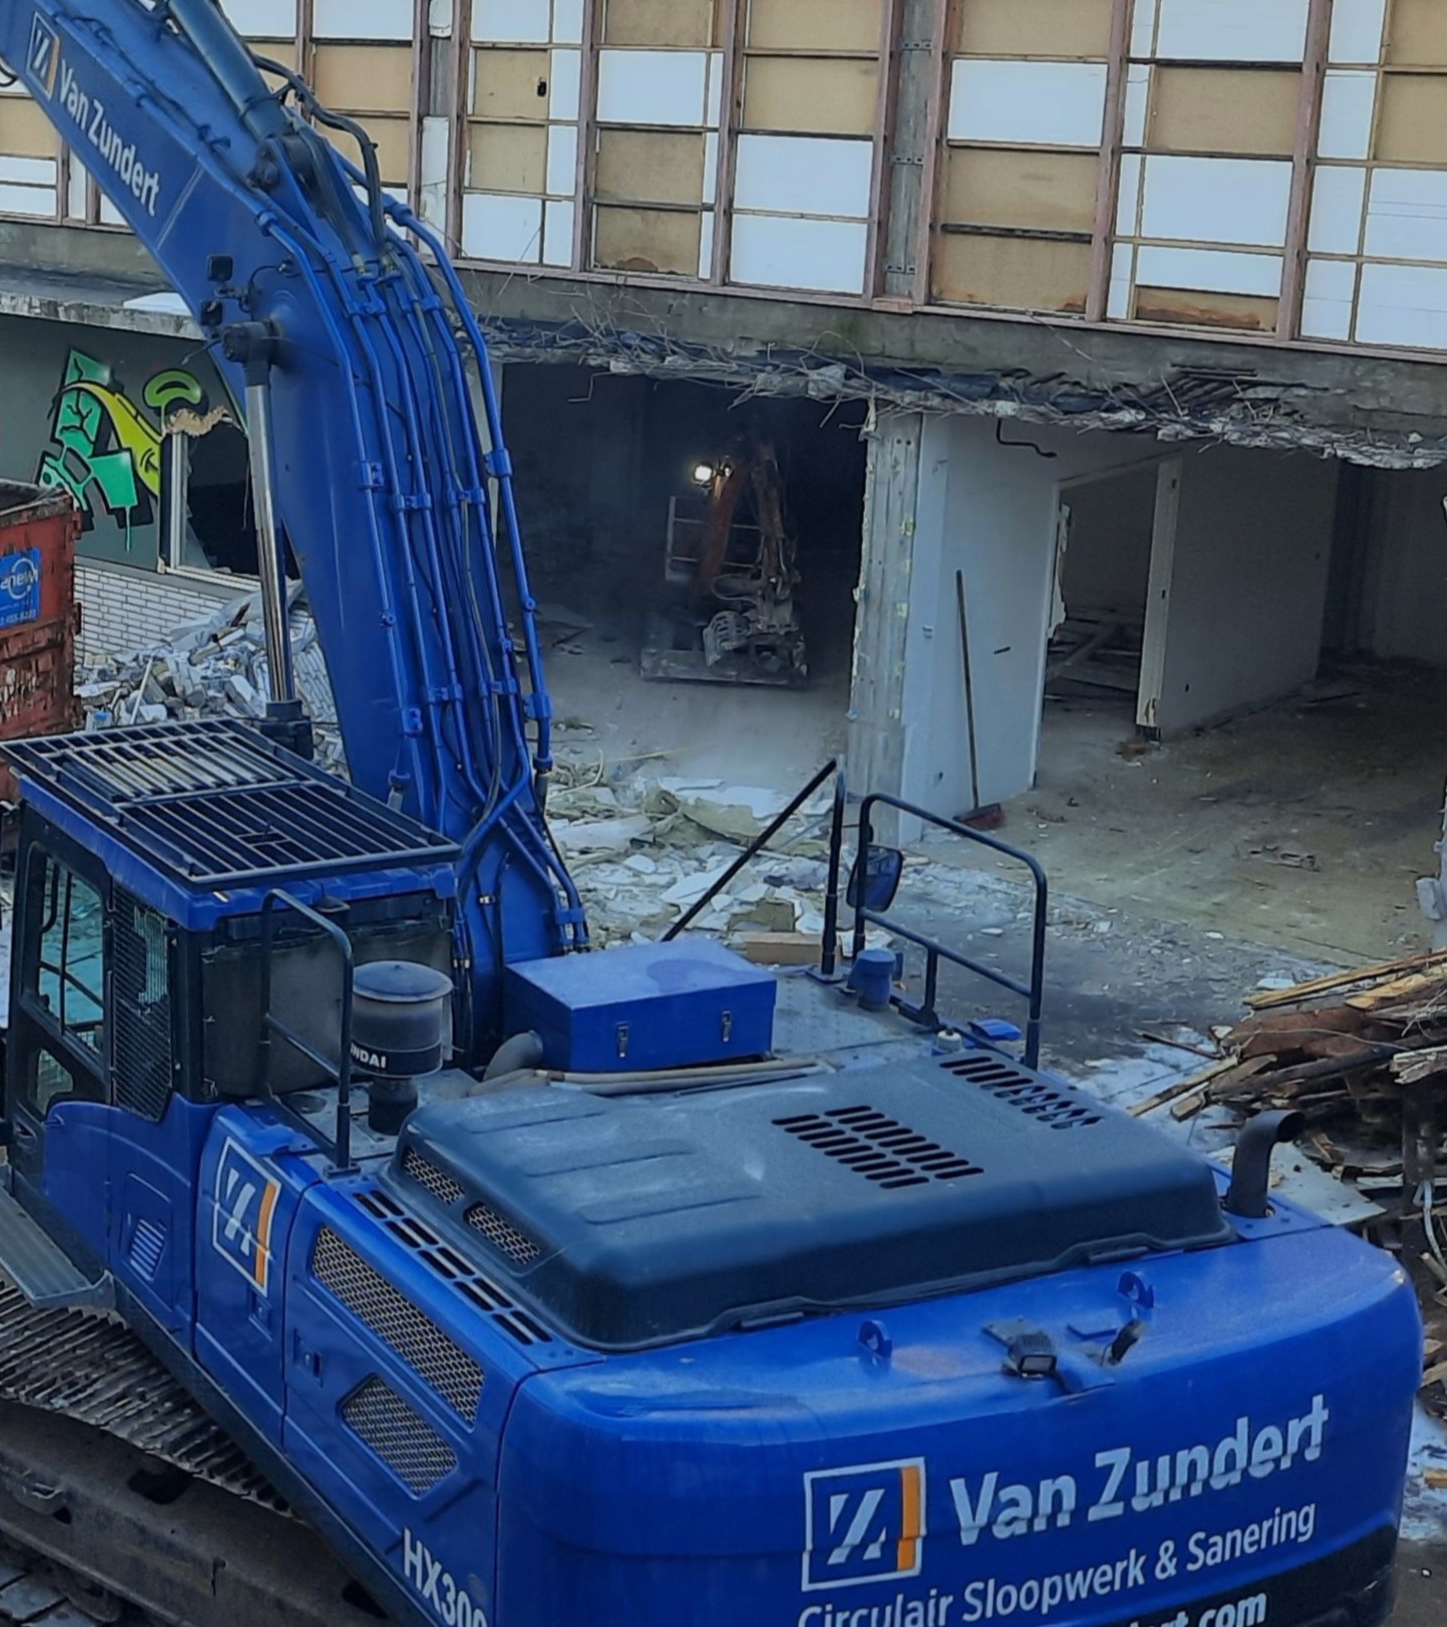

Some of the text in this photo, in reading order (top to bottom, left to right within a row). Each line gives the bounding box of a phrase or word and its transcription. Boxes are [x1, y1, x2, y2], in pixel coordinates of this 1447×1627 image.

[59, 60, 160, 217] Van Zundert
[350, 1042, 386, 1069] NDAI
[950, 1394, 1329, 1546] Van Zundert
[963, 1548, 1147, 1622] Sloopwerk
[1154, 1539, 1177, 1581] &
[1186, 1503, 1316, 1571] Sanering
